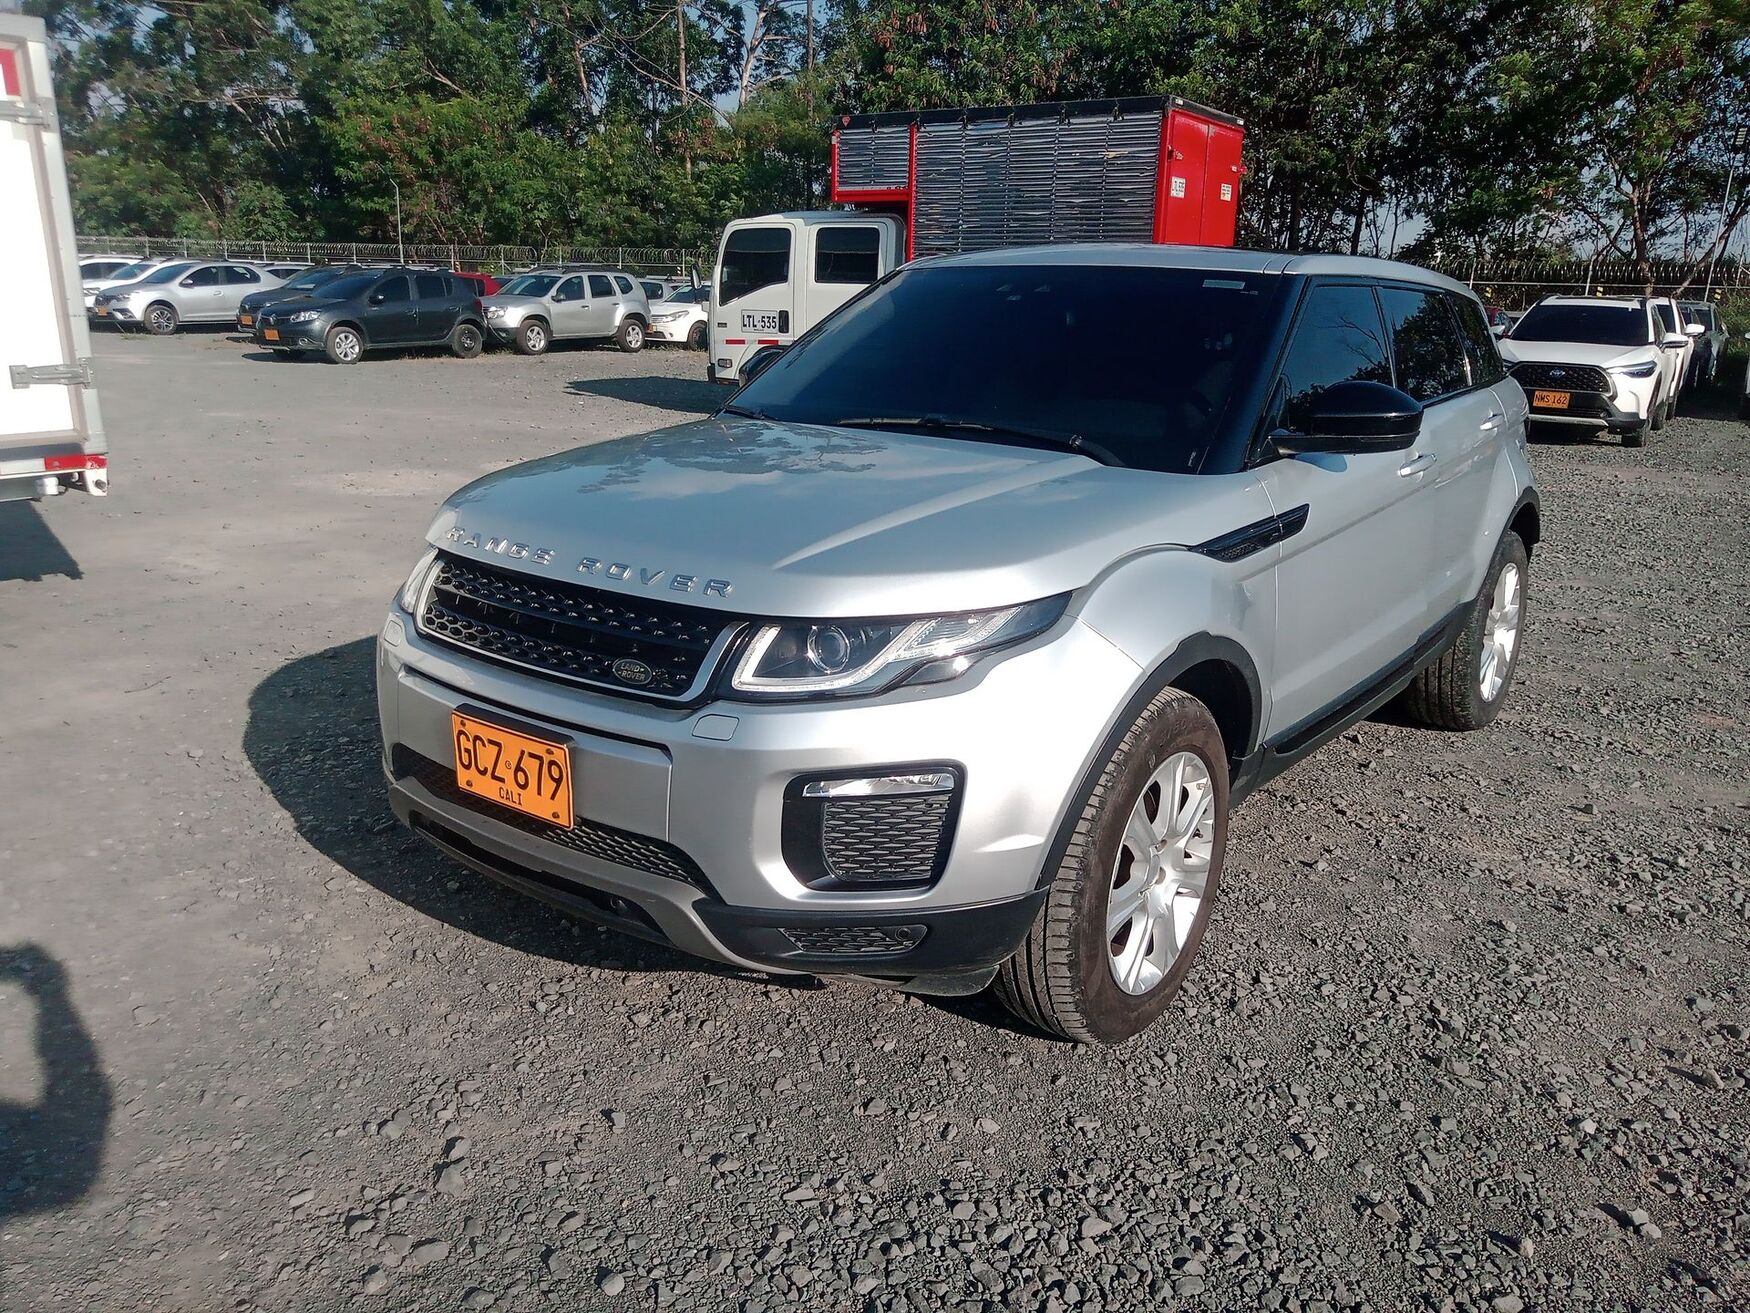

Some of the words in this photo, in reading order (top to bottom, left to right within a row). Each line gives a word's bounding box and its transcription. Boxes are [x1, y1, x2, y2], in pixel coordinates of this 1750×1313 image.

[447, 525, 555, 566] RANGE
[576, 556, 734, 598] ROVER
[621, 670, 646, 681] ROVER
[499, 786, 523, 807] CALI
